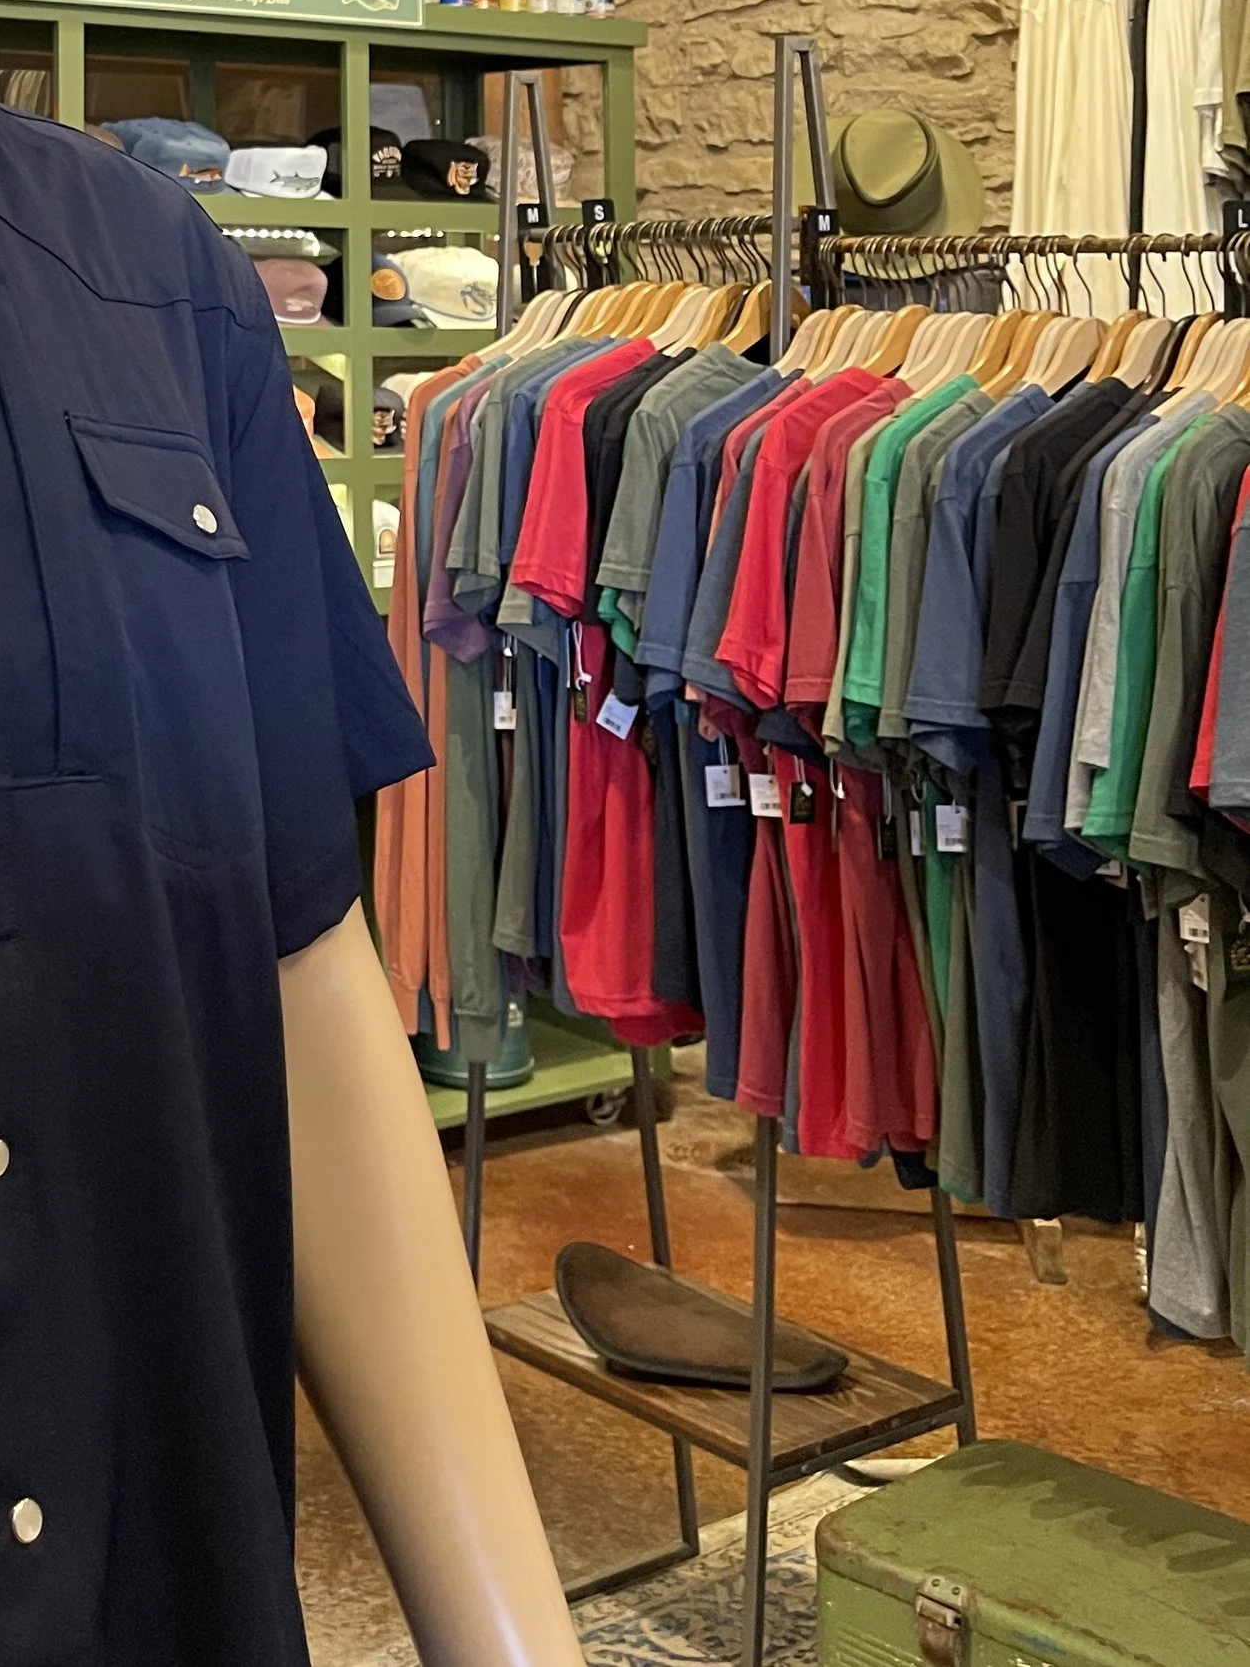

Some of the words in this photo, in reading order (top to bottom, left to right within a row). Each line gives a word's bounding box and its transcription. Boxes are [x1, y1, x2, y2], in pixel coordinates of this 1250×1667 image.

[527, 208, 538, 223] M
[595, 205, 604, 221] S
[1238, 208, 1248, 228] L
[818, 214, 830, 232] M
